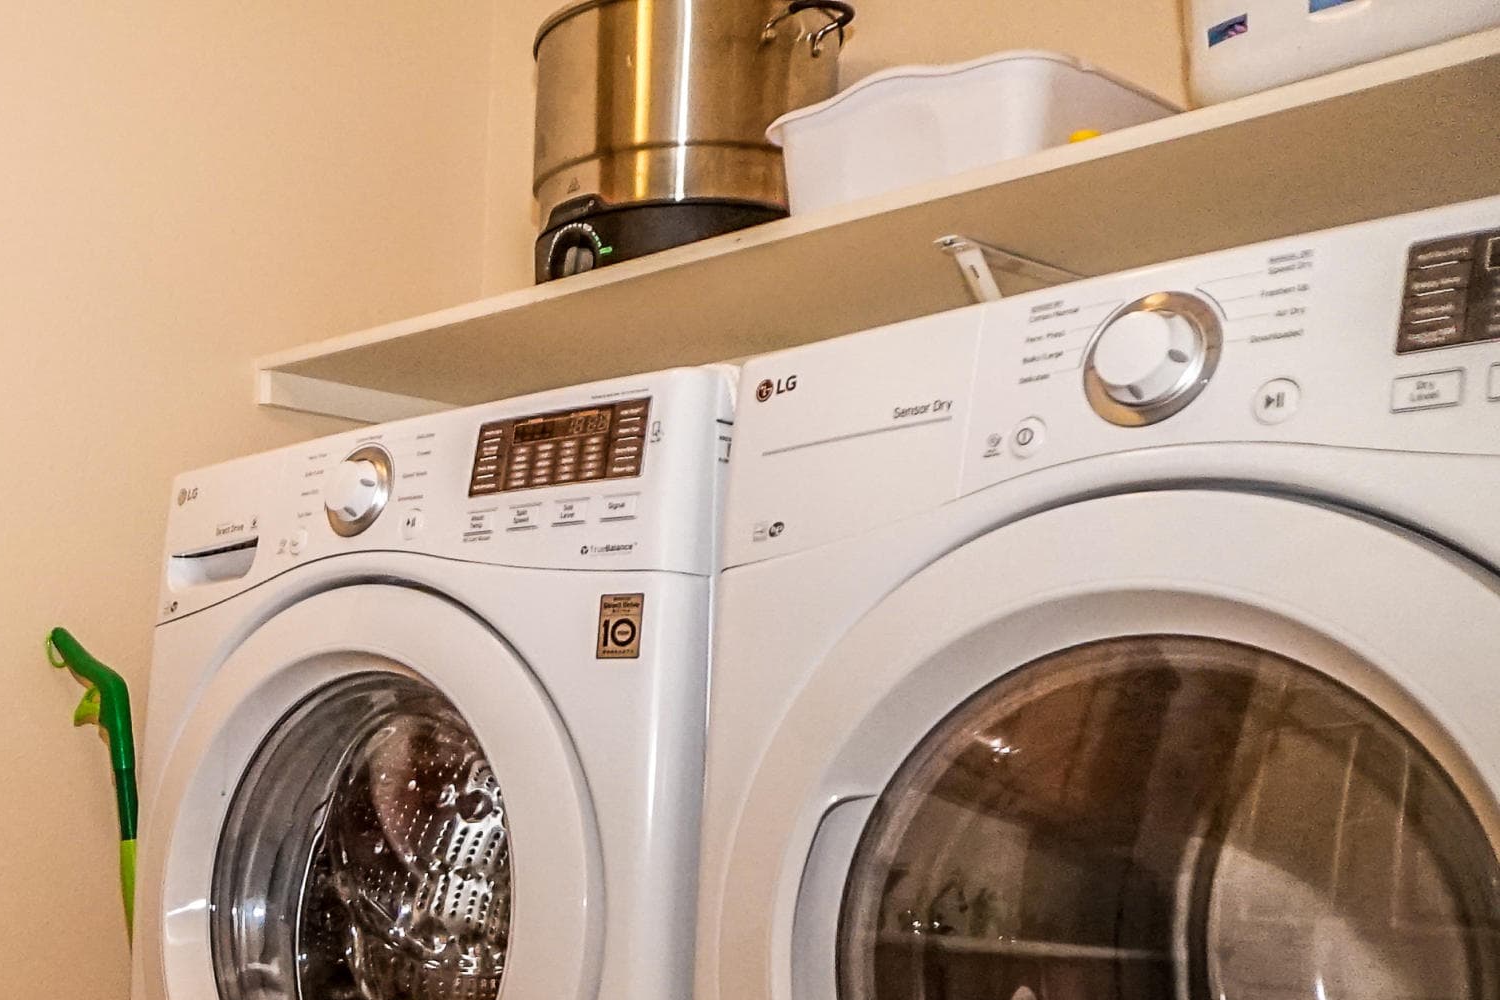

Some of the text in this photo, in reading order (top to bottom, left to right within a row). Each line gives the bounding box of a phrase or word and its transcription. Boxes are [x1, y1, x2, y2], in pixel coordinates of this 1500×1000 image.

[776, 375, 797, 395] LG
[892, 398, 953, 419] Sensor Dry
[186, 488, 198, 502] LG
[602, 618, 637, 647] 10
